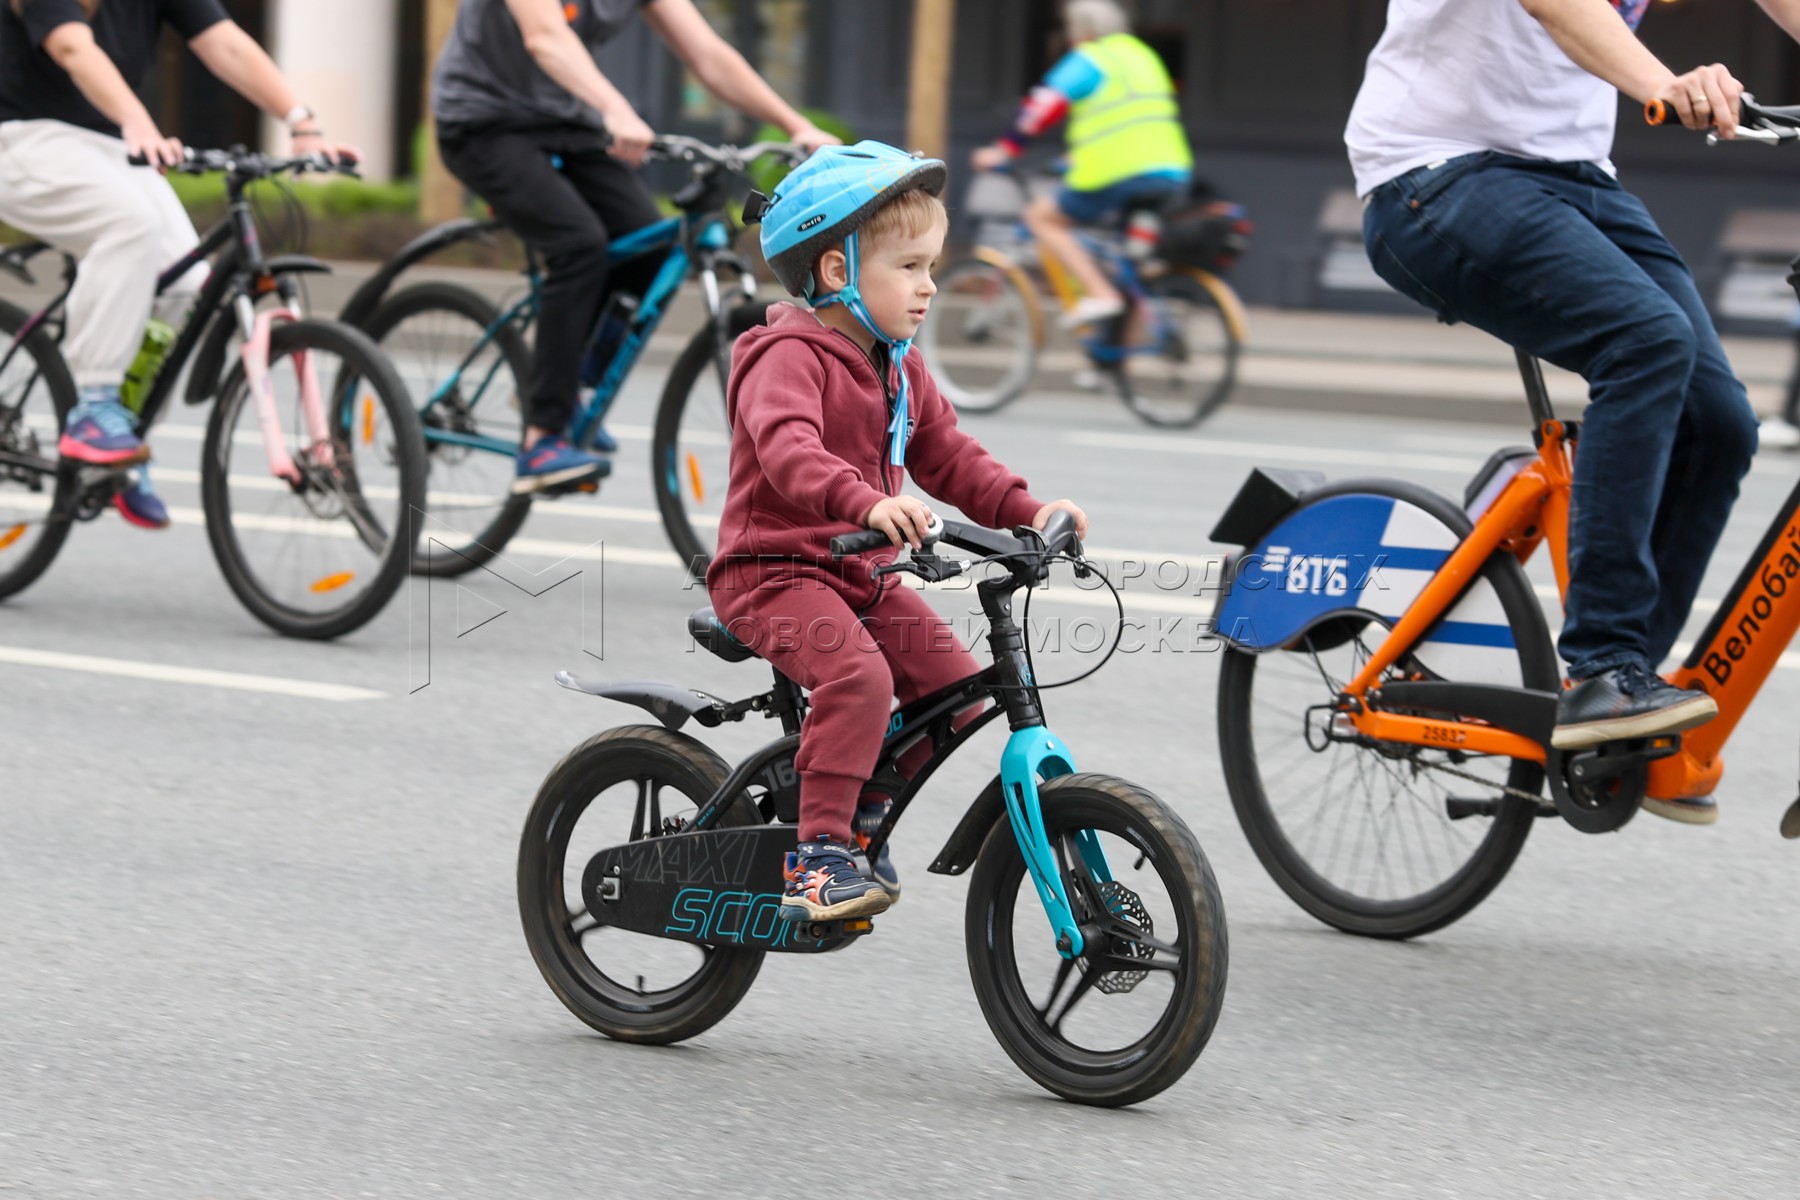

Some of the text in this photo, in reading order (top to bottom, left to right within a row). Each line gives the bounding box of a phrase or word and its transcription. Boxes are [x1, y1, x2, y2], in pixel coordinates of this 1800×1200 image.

[1286, 555, 1348, 597] ВТБ
[760, 759, 797, 792] 16
[603, 831, 761, 885] MAXI
[665, 887, 824, 948] SCO
